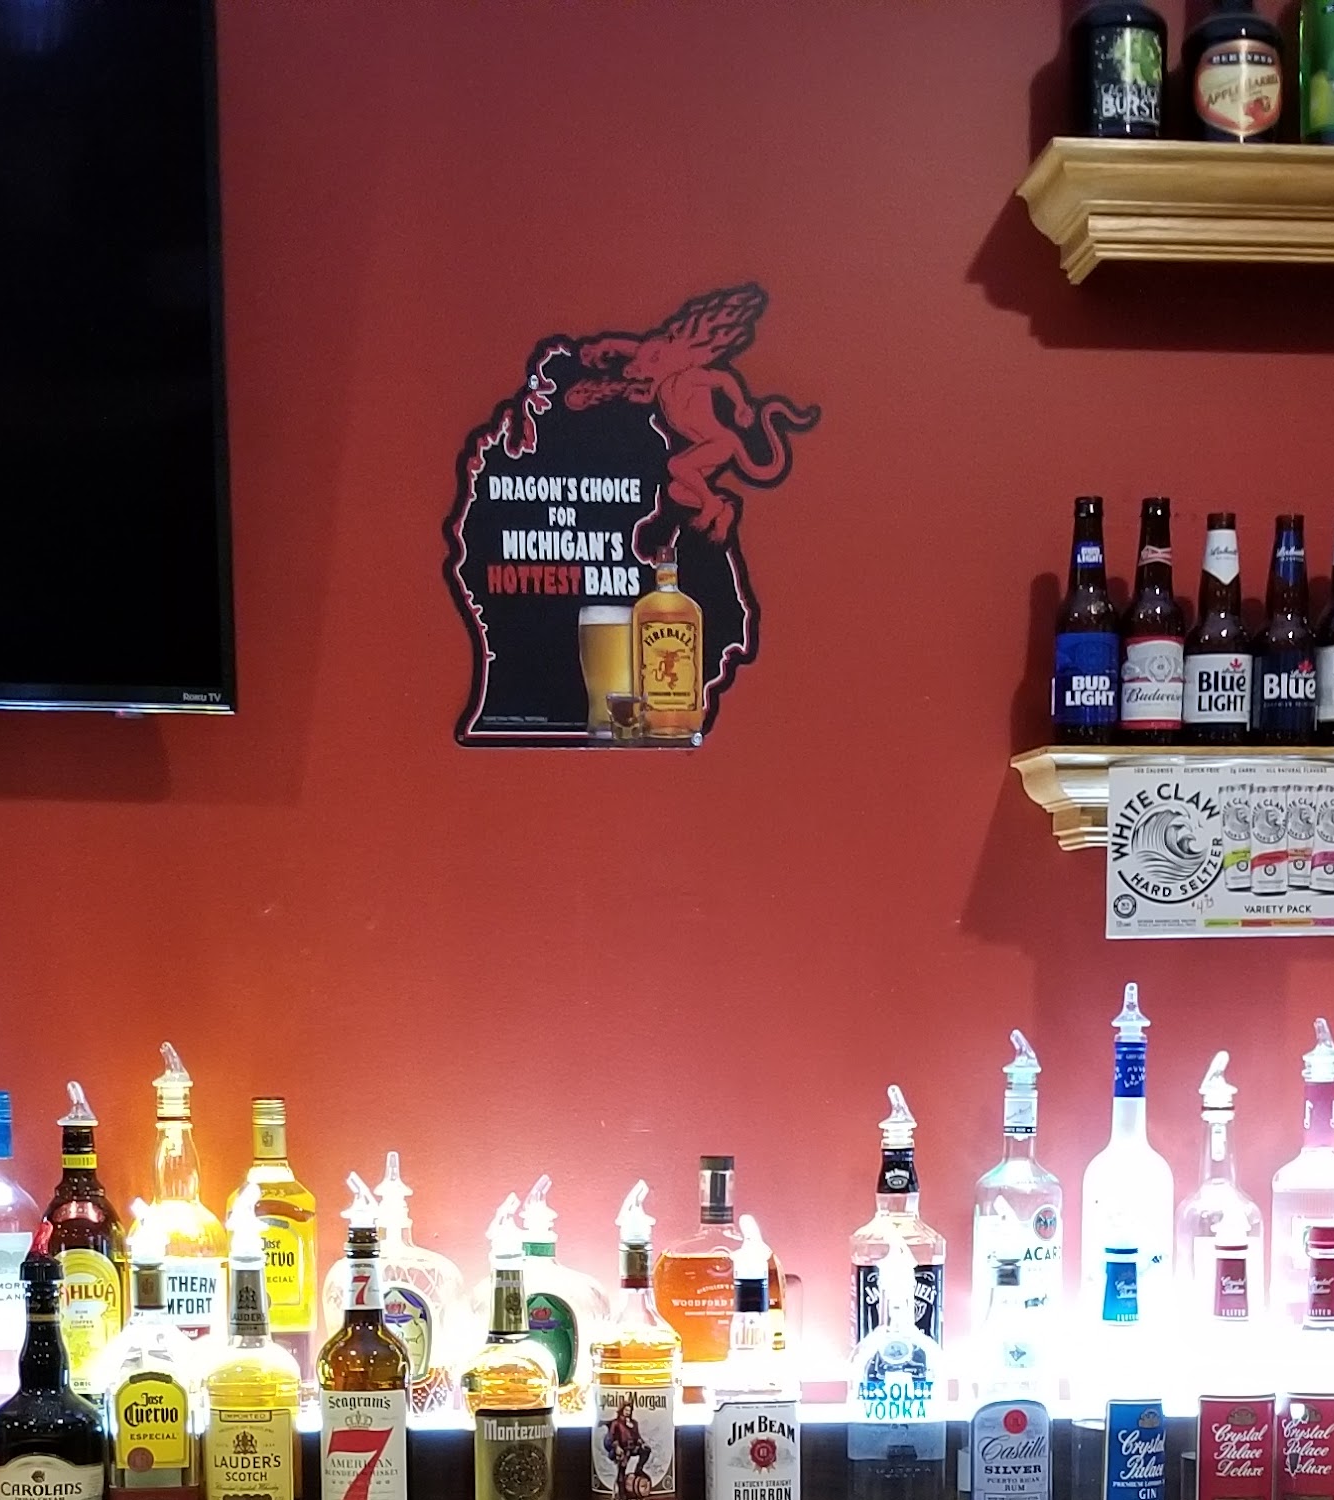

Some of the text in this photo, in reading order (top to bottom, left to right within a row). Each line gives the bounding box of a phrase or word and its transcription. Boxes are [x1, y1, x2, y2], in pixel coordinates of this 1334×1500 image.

[489, 476, 641, 503] DRAGON'S CHOICE
[548, 506, 577, 527] FOR
[502, 530, 624, 561] MICHIGAN'S
[487, 565, 640, 596] HOTTEST BARS
[644, 627, 692, 647] FIREBALL
[1072, 675, 1111, 691] BUD
[1198, 671, 1247, 693] Blue
[1263, 672, 1317, 700] Blue
[208, 692, 222, 702] TV
[1064, 690, 1116, 706] LIGHT
[1197, 694, 1246, 712] LIGHT
[1111, 782, 1220, 862] WHITE CLAW
[1130, 837, 1224, 898] HARD SELTZER
[1244, 904, 1313, 914] VARIETY PACK
[167, 1276, 216, 1294] THERN
[351, 1275, 372, 1305] 7
[167, 1297, 213, 1315] MFORT
[671, 1298, 729, 1307] WOODFORD
[141, 1392, 164, 1407] Jose
[856, 1380, 934, 1402] ABSOLUT
[328, 1395, 391, 1412] Seagram's
[627, 1392, 667, 1411] Morgan
[863, 1400, 926, 1419] VODKA
[124, 1402, 179, 1427] Cuervo
[130, 1432, 177, 1441] ESPECIAL
[727, 1415, 796, 1447] JIM BEAM
[1212, 1423, 1269, 1445] Crystal
[1213, 1442, 1264, 1460] Palace
[214, 1453, 281, 1469] LAUDER'S
[984, 1464, 1042, 1475] SILVER
[1215, 1458, 1265, 1478] Deluxe
[225, 1471, 268, 1482] SCOTCH
[734, 1479, 792, 1488] KENTUCKY STRAIGHT
[0, 1481, 83, 1497] CAROLANS
[1004, 1484, 1026, 1492] RUM
[1138, 1488, 1157, 1500] GIN
